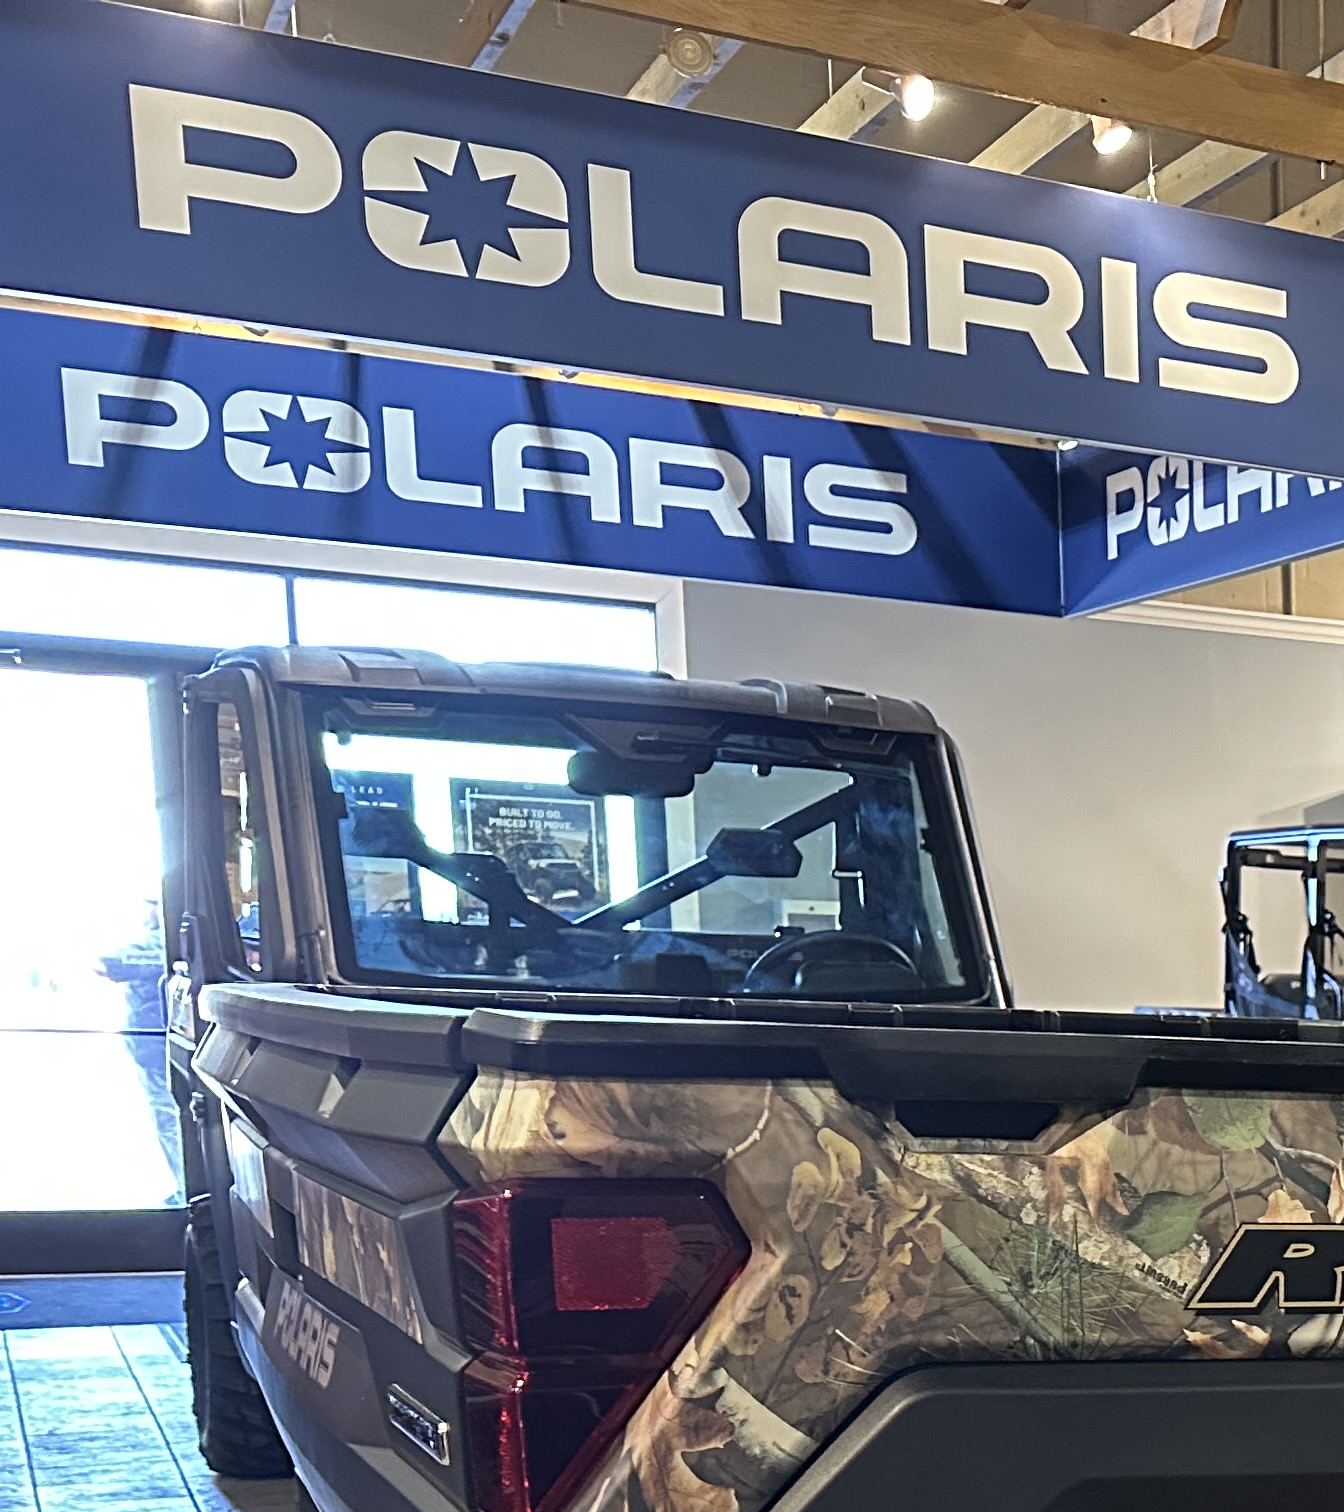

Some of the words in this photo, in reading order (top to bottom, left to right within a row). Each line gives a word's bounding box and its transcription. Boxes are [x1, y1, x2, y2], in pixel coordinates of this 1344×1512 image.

[129, 84, 1300, 404] POLARIS
[62, 367, 918, 556] POLARIS
[1106, 456, 1343, 560] POLA
[488, 817, 527, 828] PRICED
[528, 819, 542, 829] TO
[499, 807, 528, 818] BUILT
[531, 810, 544, 818] TO
[274, 1280, 340, 1389] POLARIS
